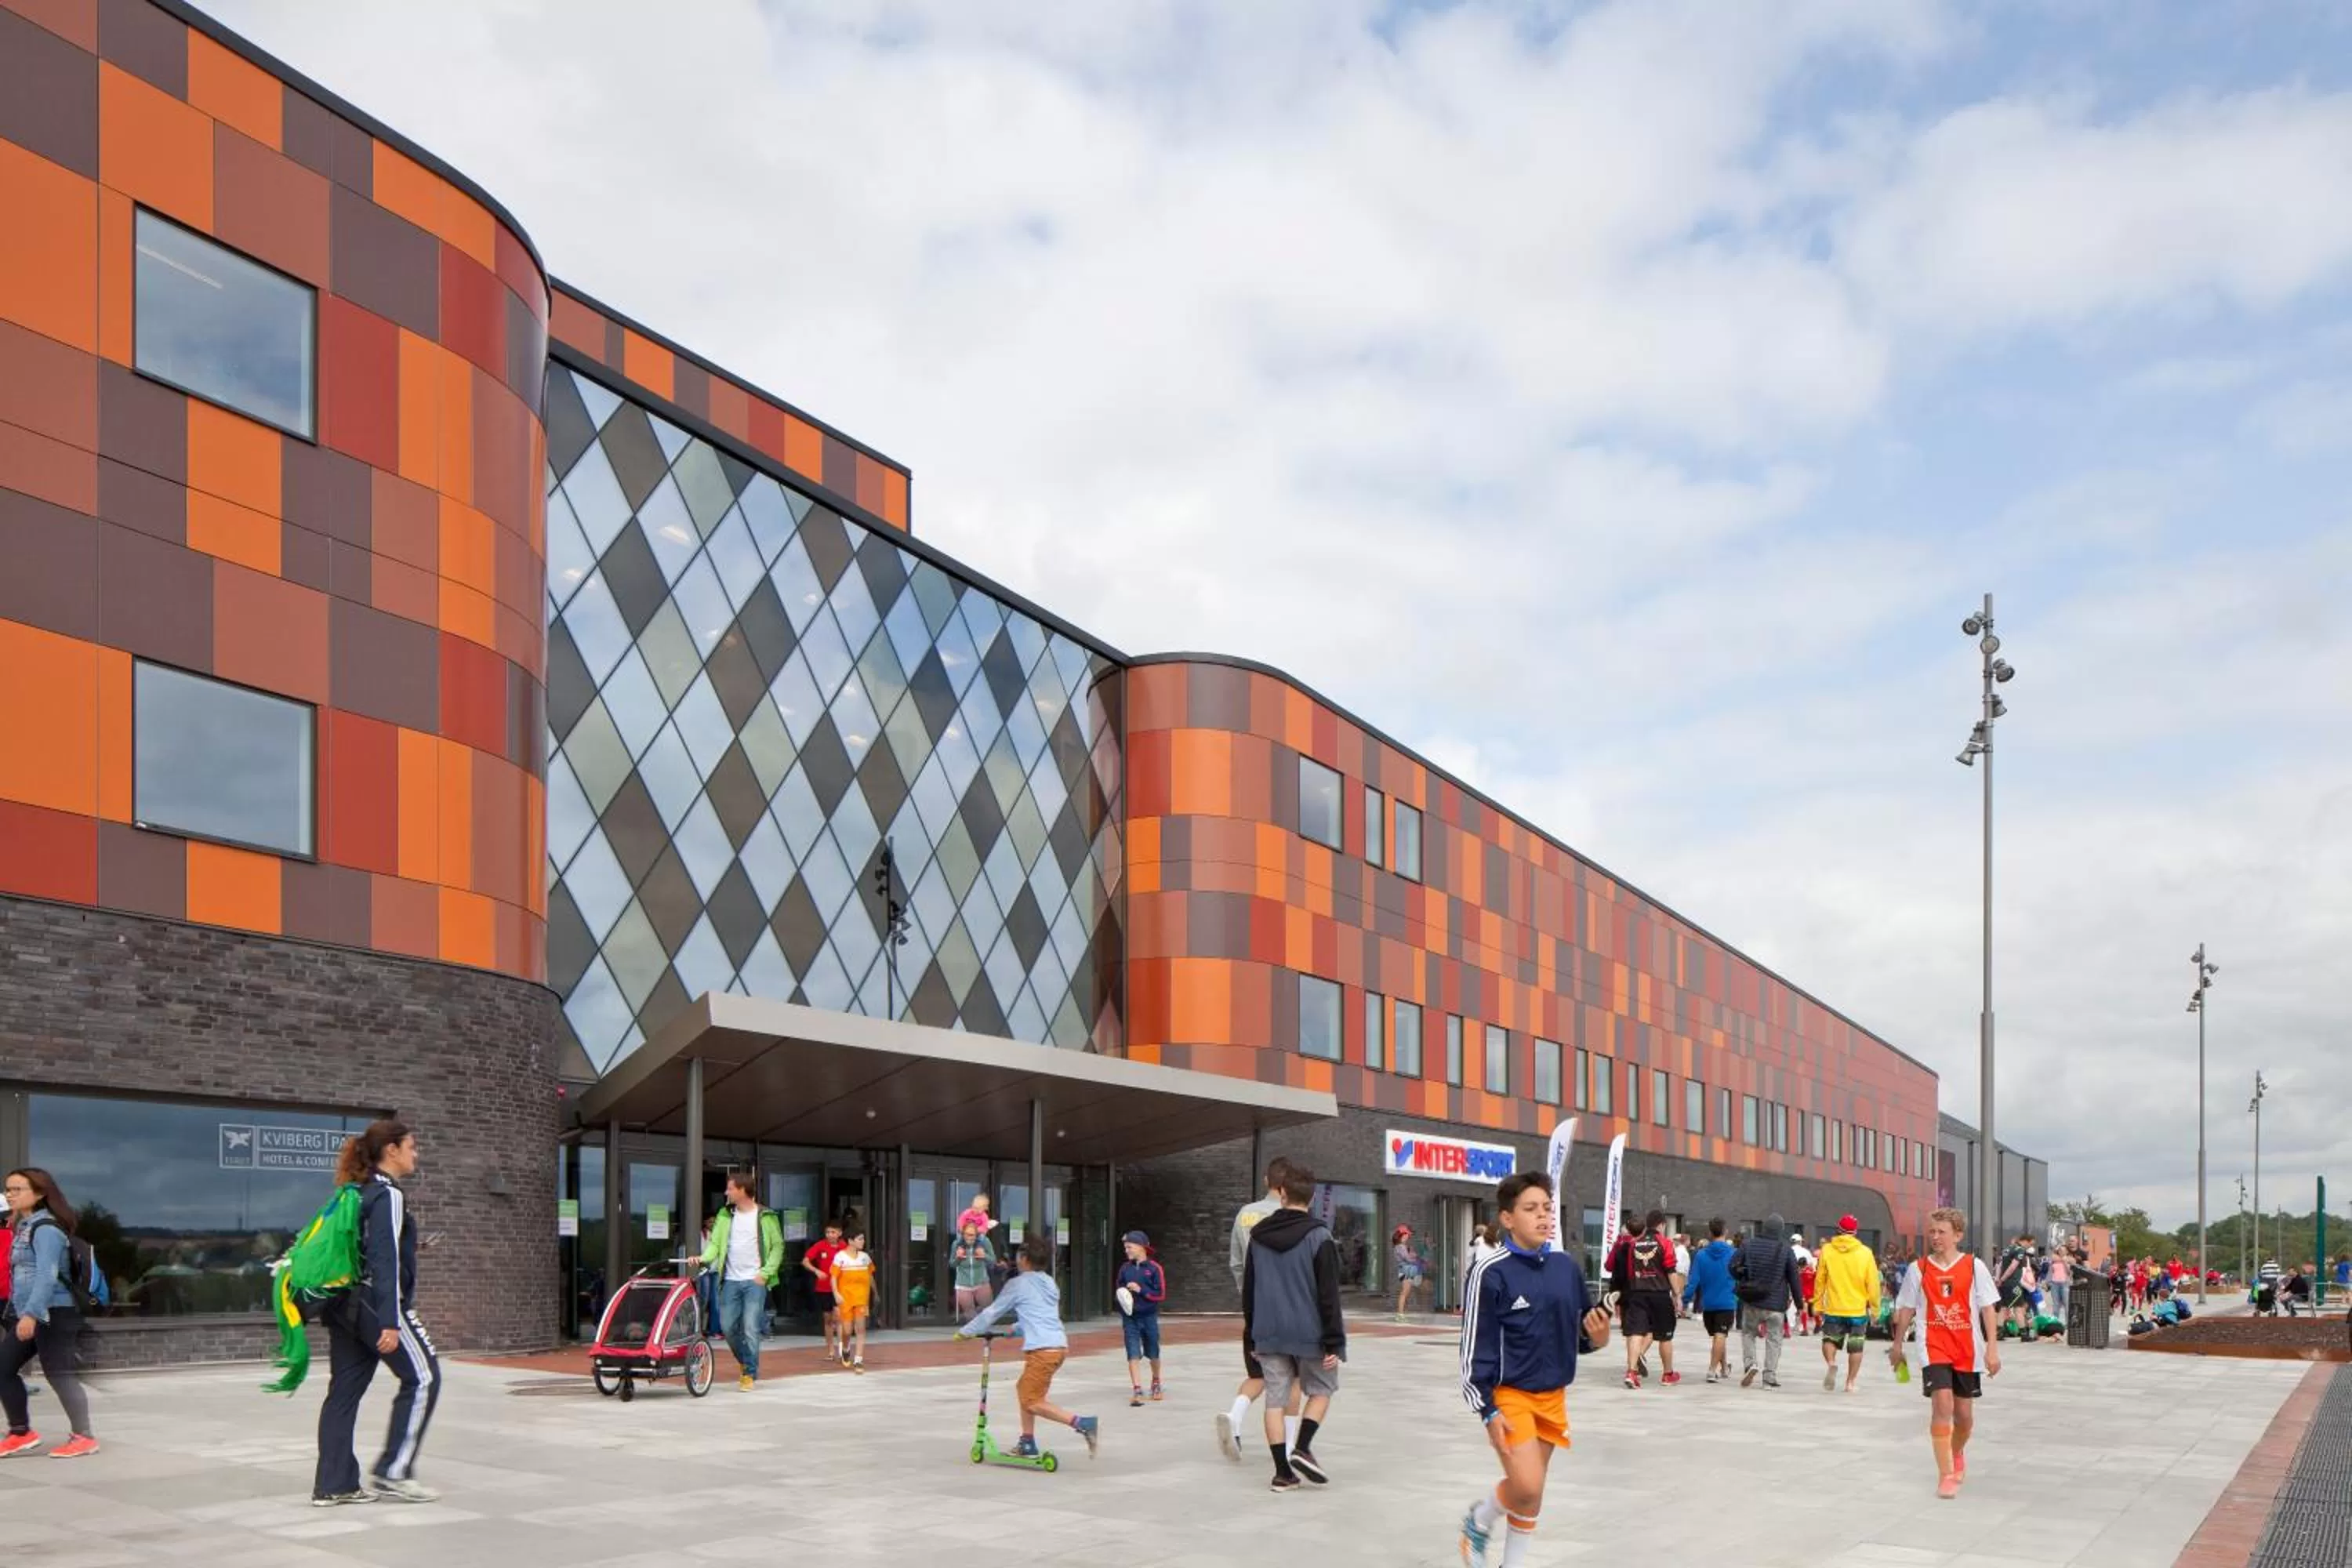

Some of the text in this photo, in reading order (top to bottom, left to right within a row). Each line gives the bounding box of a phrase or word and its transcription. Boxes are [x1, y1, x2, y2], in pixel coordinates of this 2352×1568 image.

[262, 1131, 322, 1149] KVIBERG
[263, 1154, 294, 1165] HOTEL
[1414, 1141, 1515, 1178] INTERSPORT
